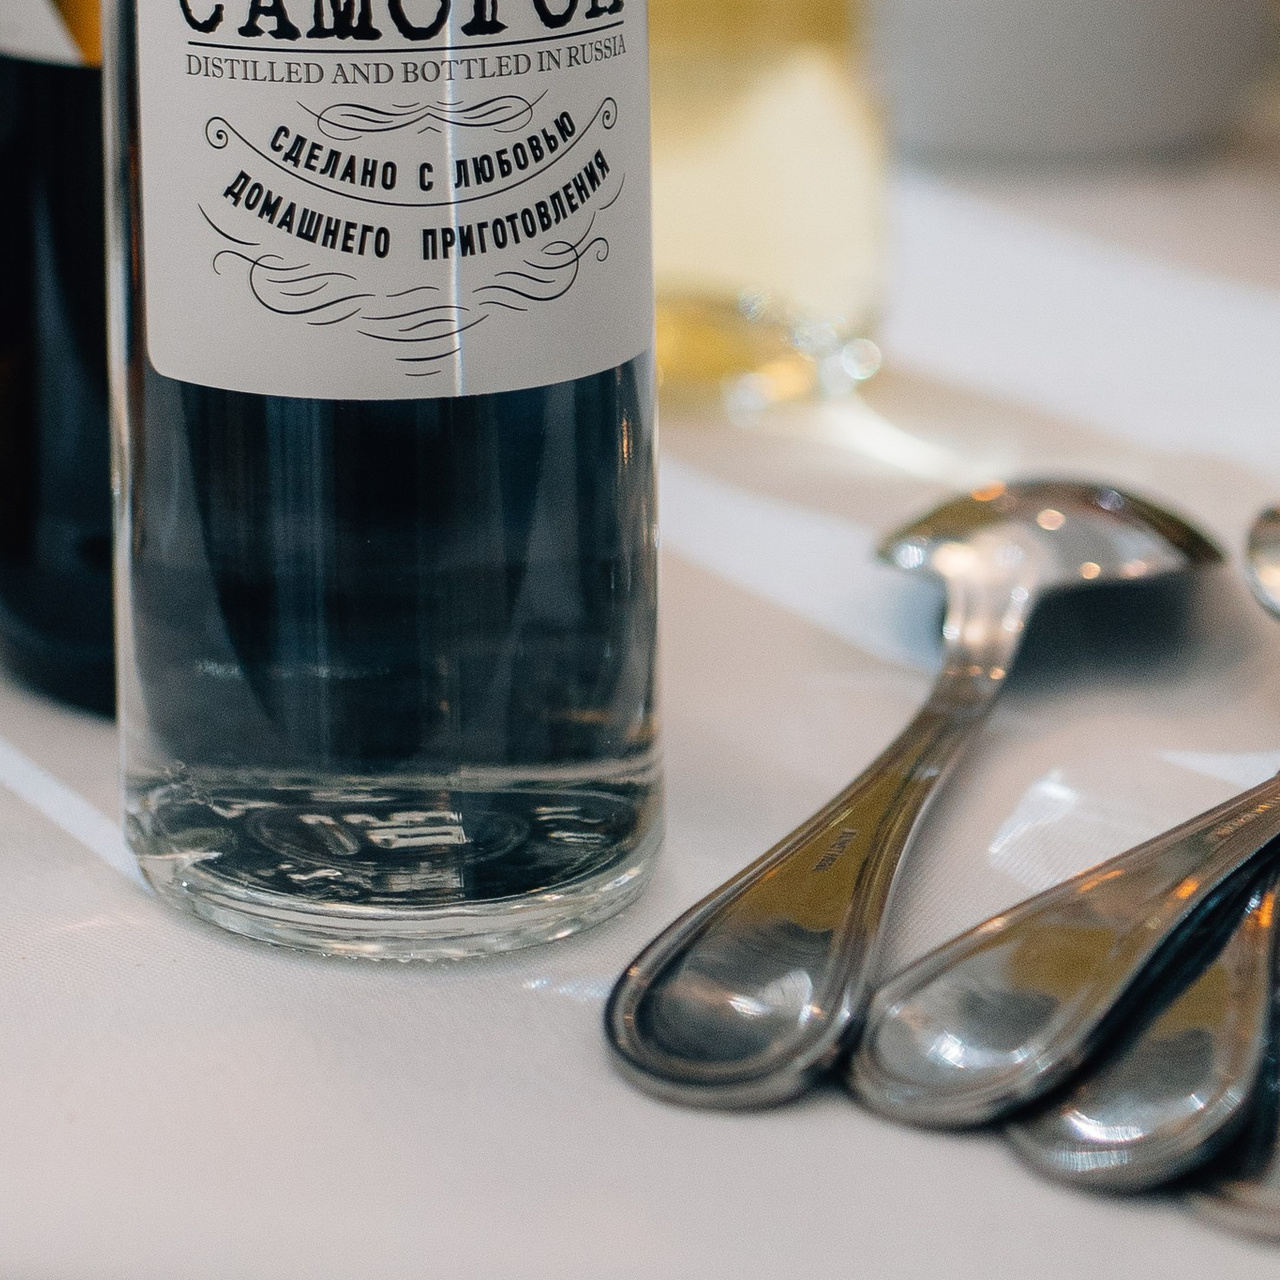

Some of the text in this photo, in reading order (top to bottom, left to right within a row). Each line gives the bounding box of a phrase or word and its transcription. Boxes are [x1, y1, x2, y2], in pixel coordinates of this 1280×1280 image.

[185, 33, 628, 85] DISTILLED AND BOTTLED IN RUSSIA
[269, 109, 578, 192] СДЕЛАНО С ЛЮБОВЬЮ
[222, 148, 612, 262] ДОМАШНЕГО ПРИГОТОВЛЕНИЯ
